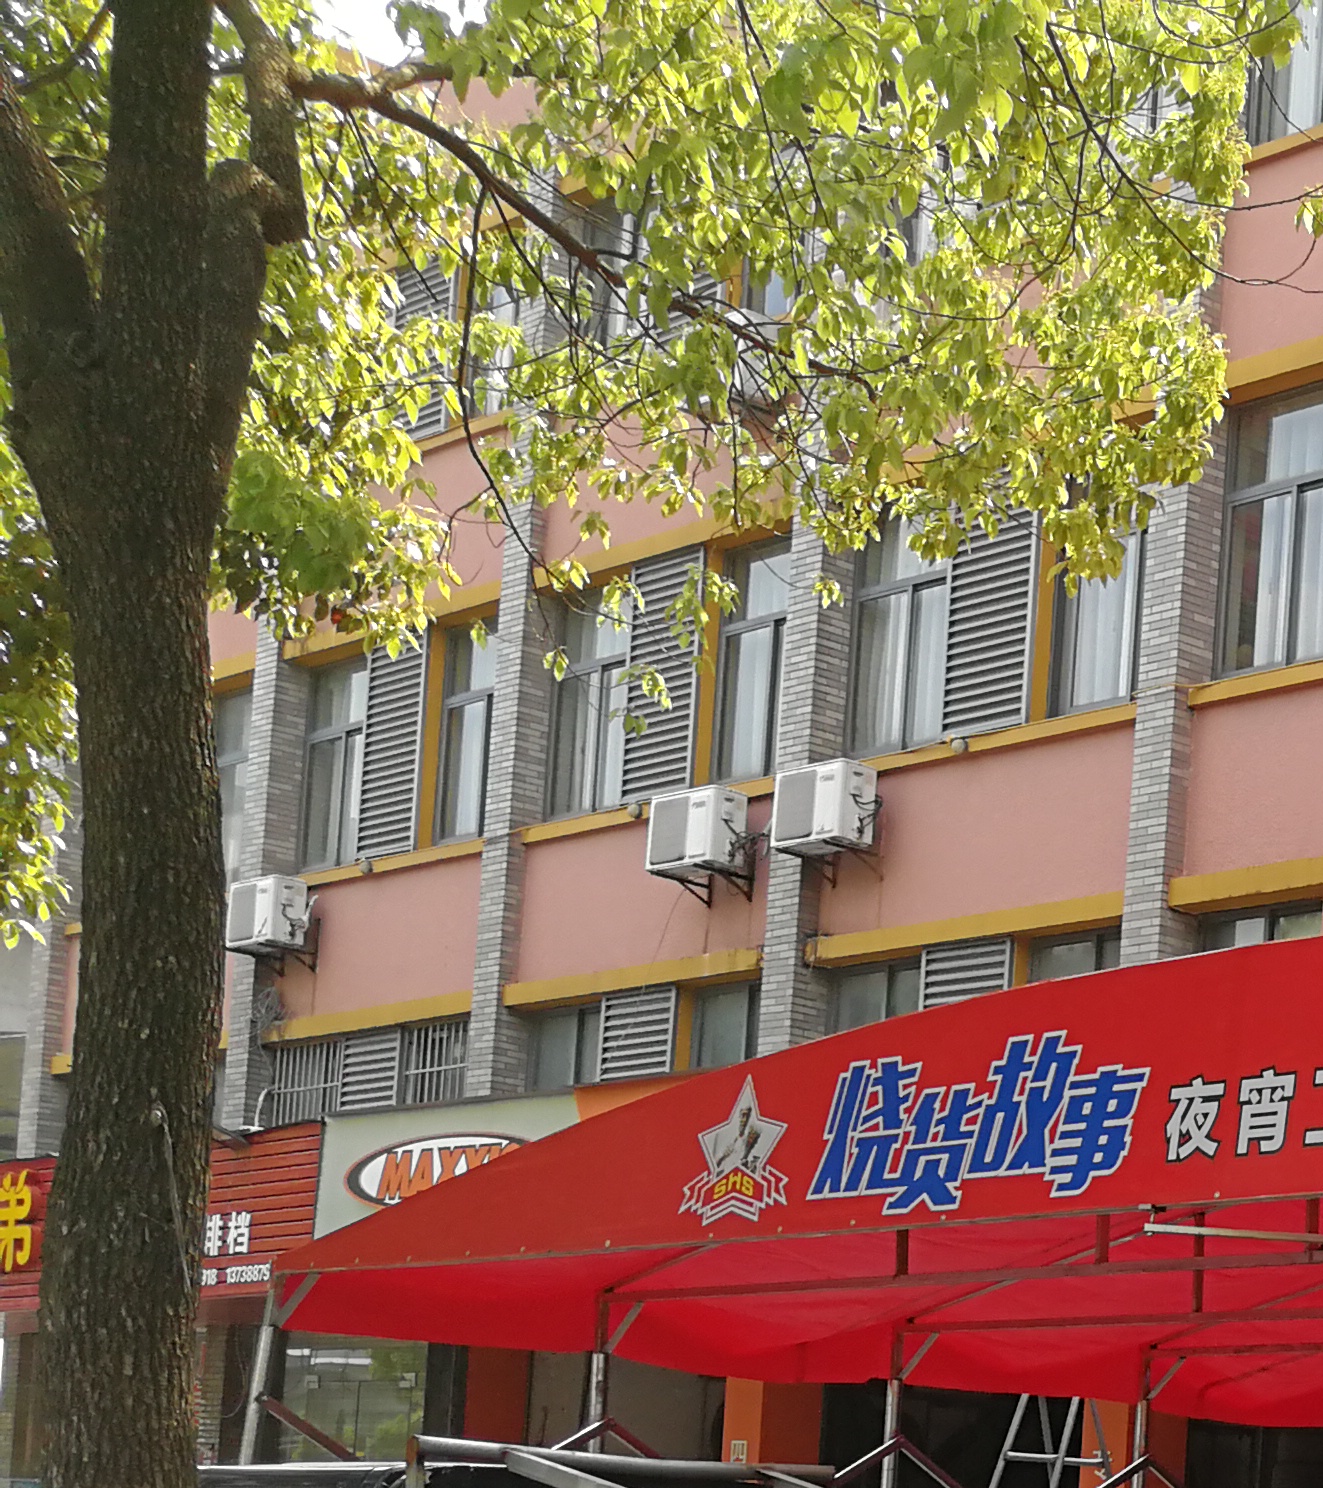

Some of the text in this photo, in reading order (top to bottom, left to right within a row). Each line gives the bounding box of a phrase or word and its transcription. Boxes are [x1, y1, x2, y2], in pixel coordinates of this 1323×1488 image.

[374, 1140, 522, 1202] MAXX
[806, 1030, 1151, 1215] 烧货故事
